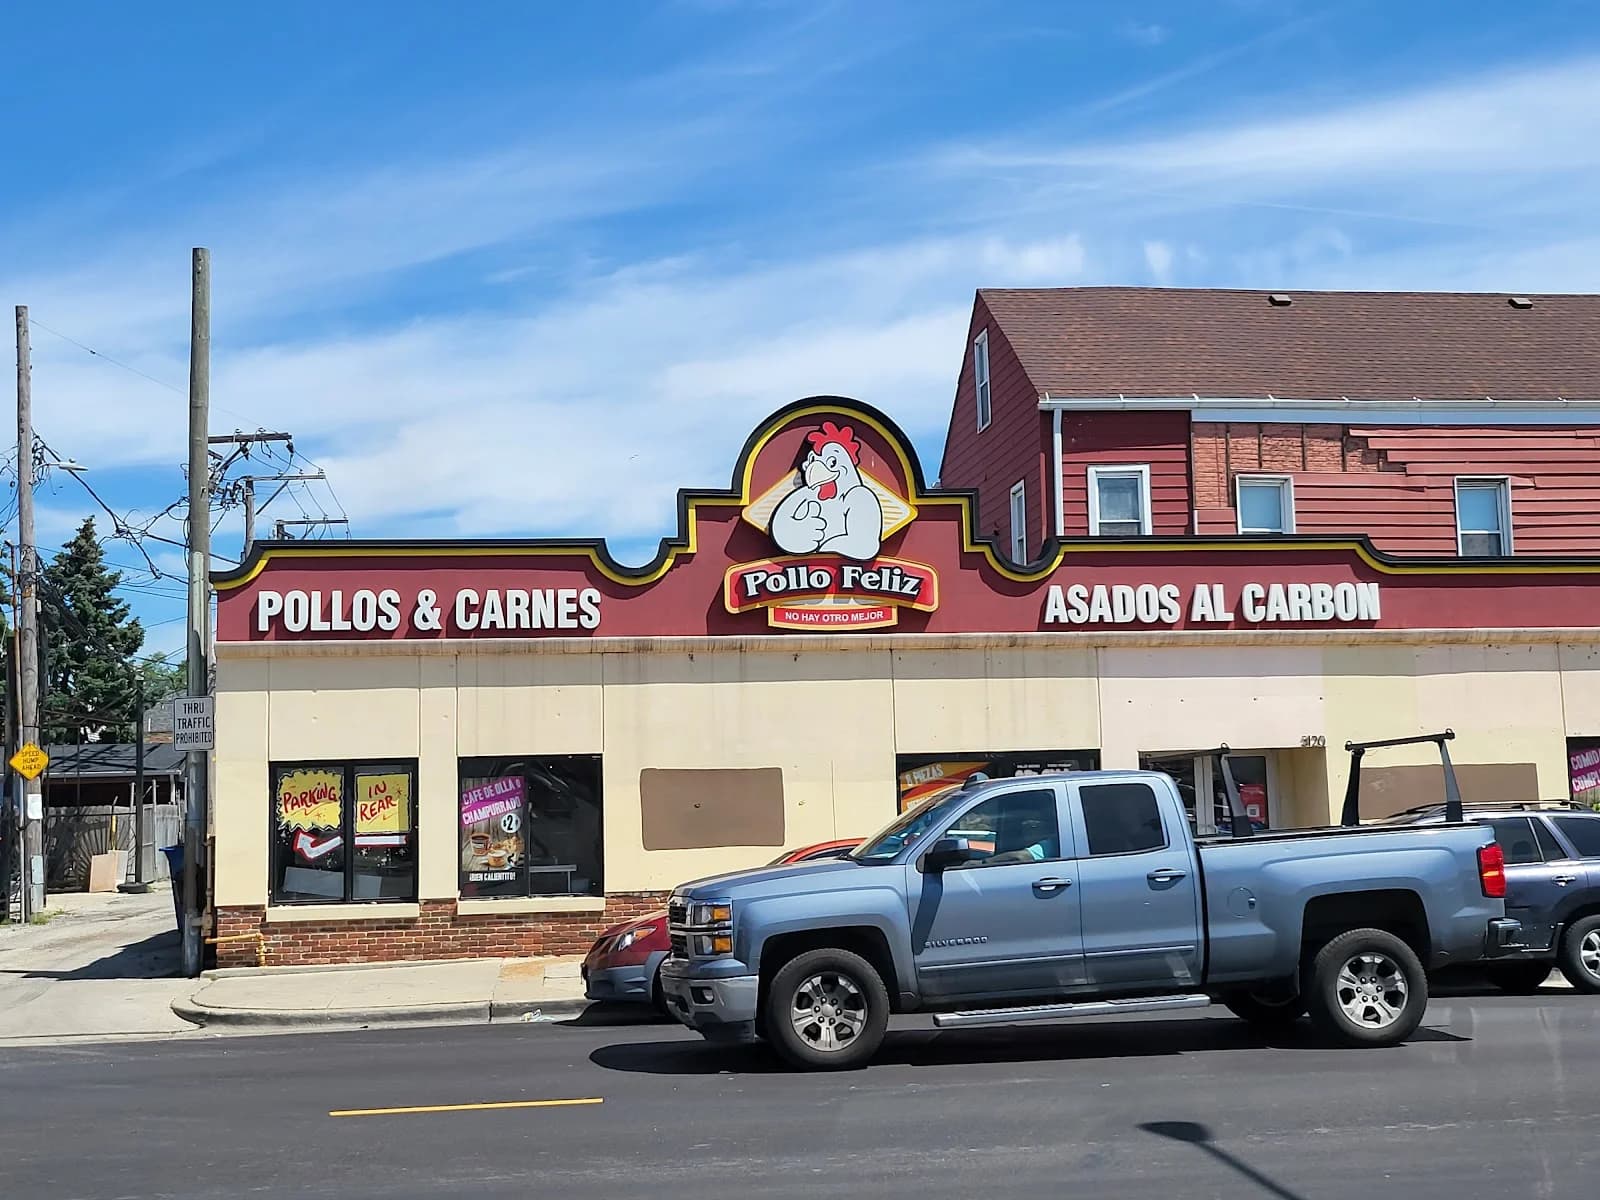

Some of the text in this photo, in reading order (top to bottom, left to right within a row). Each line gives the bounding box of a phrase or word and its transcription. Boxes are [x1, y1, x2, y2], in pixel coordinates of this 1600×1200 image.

[744, 565, 921, 597] Pollo Feliz
[257, 588, 602, 632] POLLOS & CARNES
[1044, 582, 1382, 624] ASADOS AL CARBON
[785, 610, 884, 622] NO HAY OTRO MEJOR
[183, 702, 205, 715] THRU
[177, 716, 211, 730] TRAFFIC
[176, 731, 213, 745] PROHIBITED
[22, 763, 42, 771] AHEAD
[282, 782, 337, 814] PARKING
[368, 780, 387, 799] IN
[462, 791, 484, 805] CAFE
[484, 786, 495, 798] DE
[495, 780, 517, 794] OLLA
[359, 795, 397, 822] REAR
[462, 796, 521, 825] CHAMPURRADO
[924, 936, 988, 948] SILVERADO
